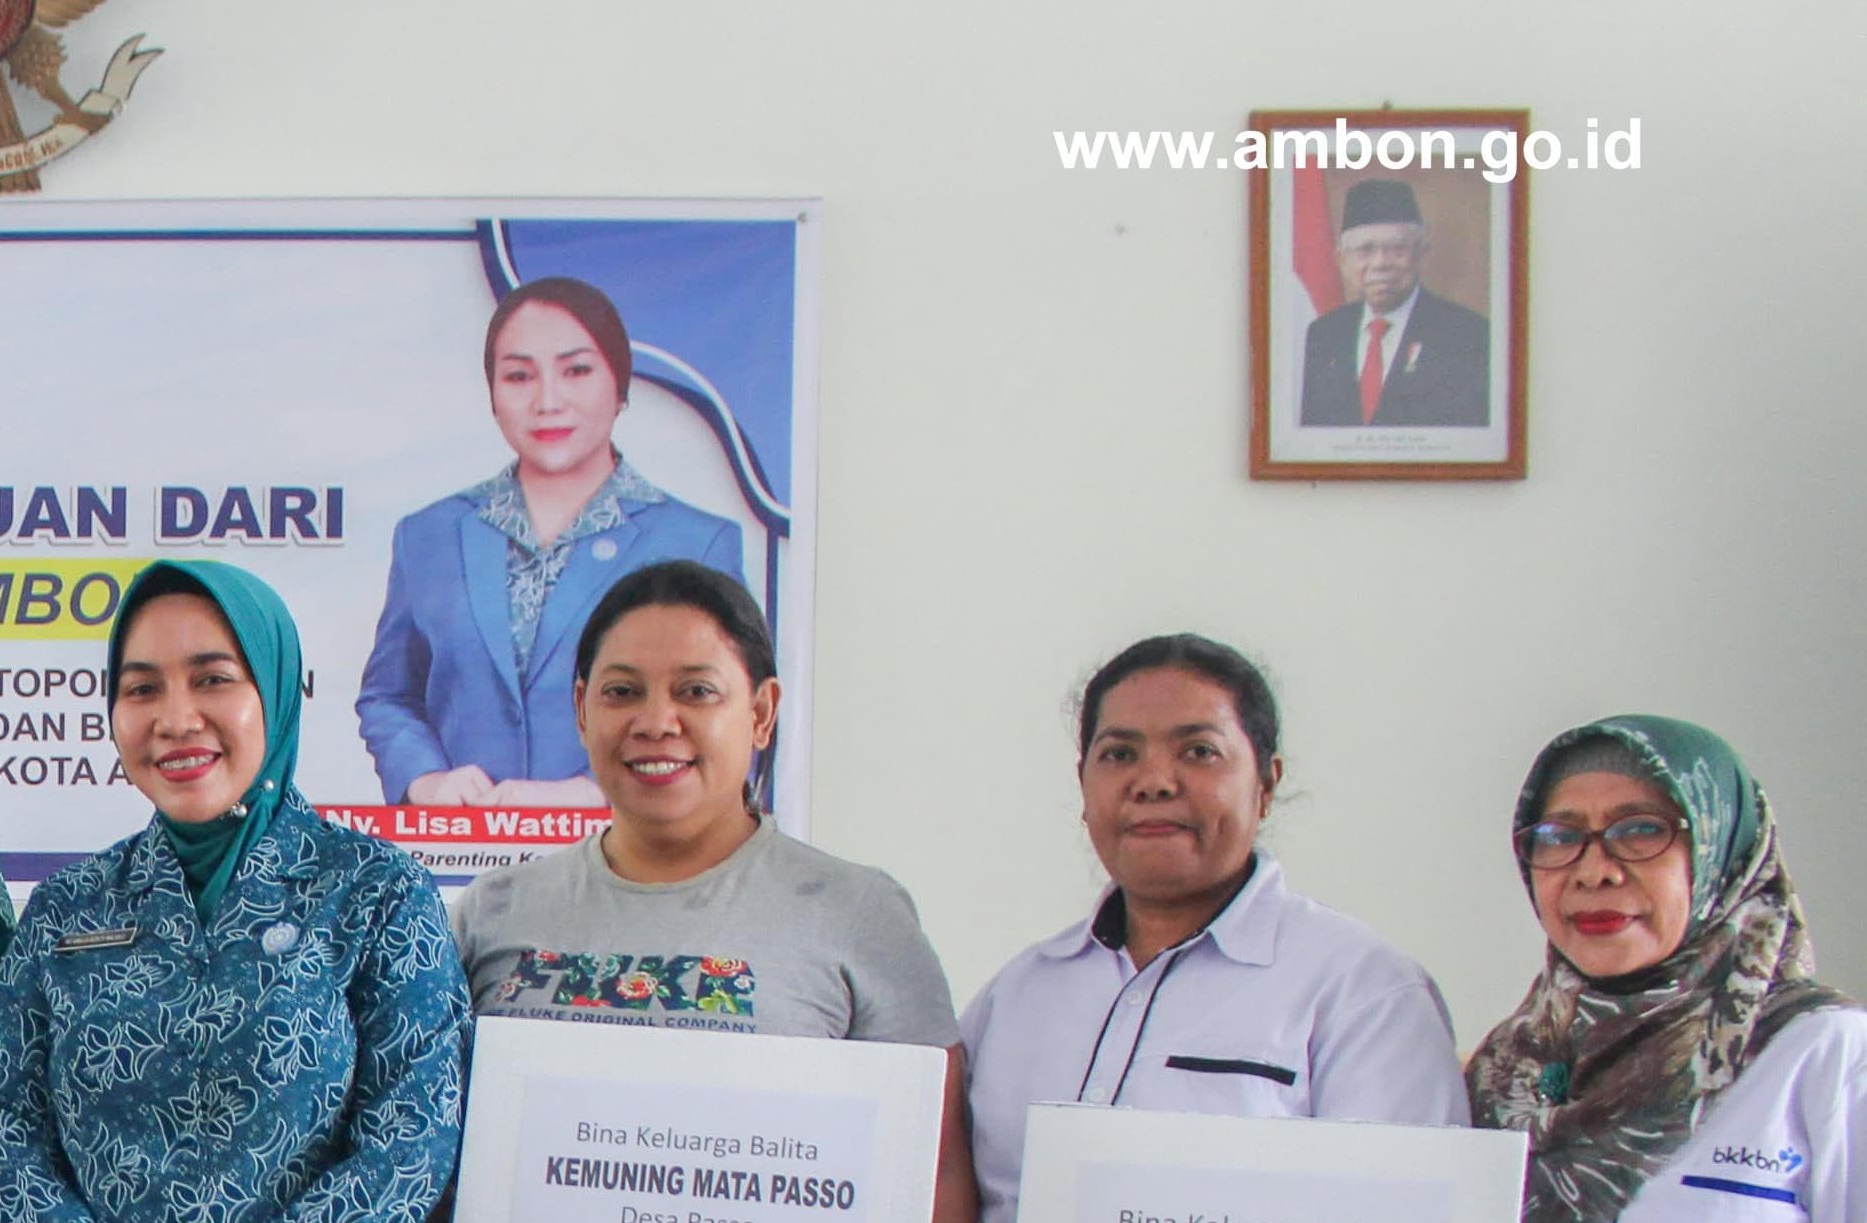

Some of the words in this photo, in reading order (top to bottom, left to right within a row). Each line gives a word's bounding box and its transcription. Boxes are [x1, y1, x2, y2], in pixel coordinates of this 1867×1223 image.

[160, 485, 344, 540] DARI
[395, 810, 472, 836] Lisa
[484, 811, 613, 837] Wattim
[571, 1013, 657, 1027] ORIGINAL
[664, 1016, 757, 1034] COMPANY
[576, 1121, 628, 1145] Bina
[635, 1126, 742, 1158] Keluarga
[749, 1135, 819, 1161] Balita
[1712, 1146, 1780, 1173] bkkbn
[545, 1155, 686, 1196] KEMUNING
[692, 1167, 762, 1203] MATA
[769, 1174, 856, 1211] PASSO
